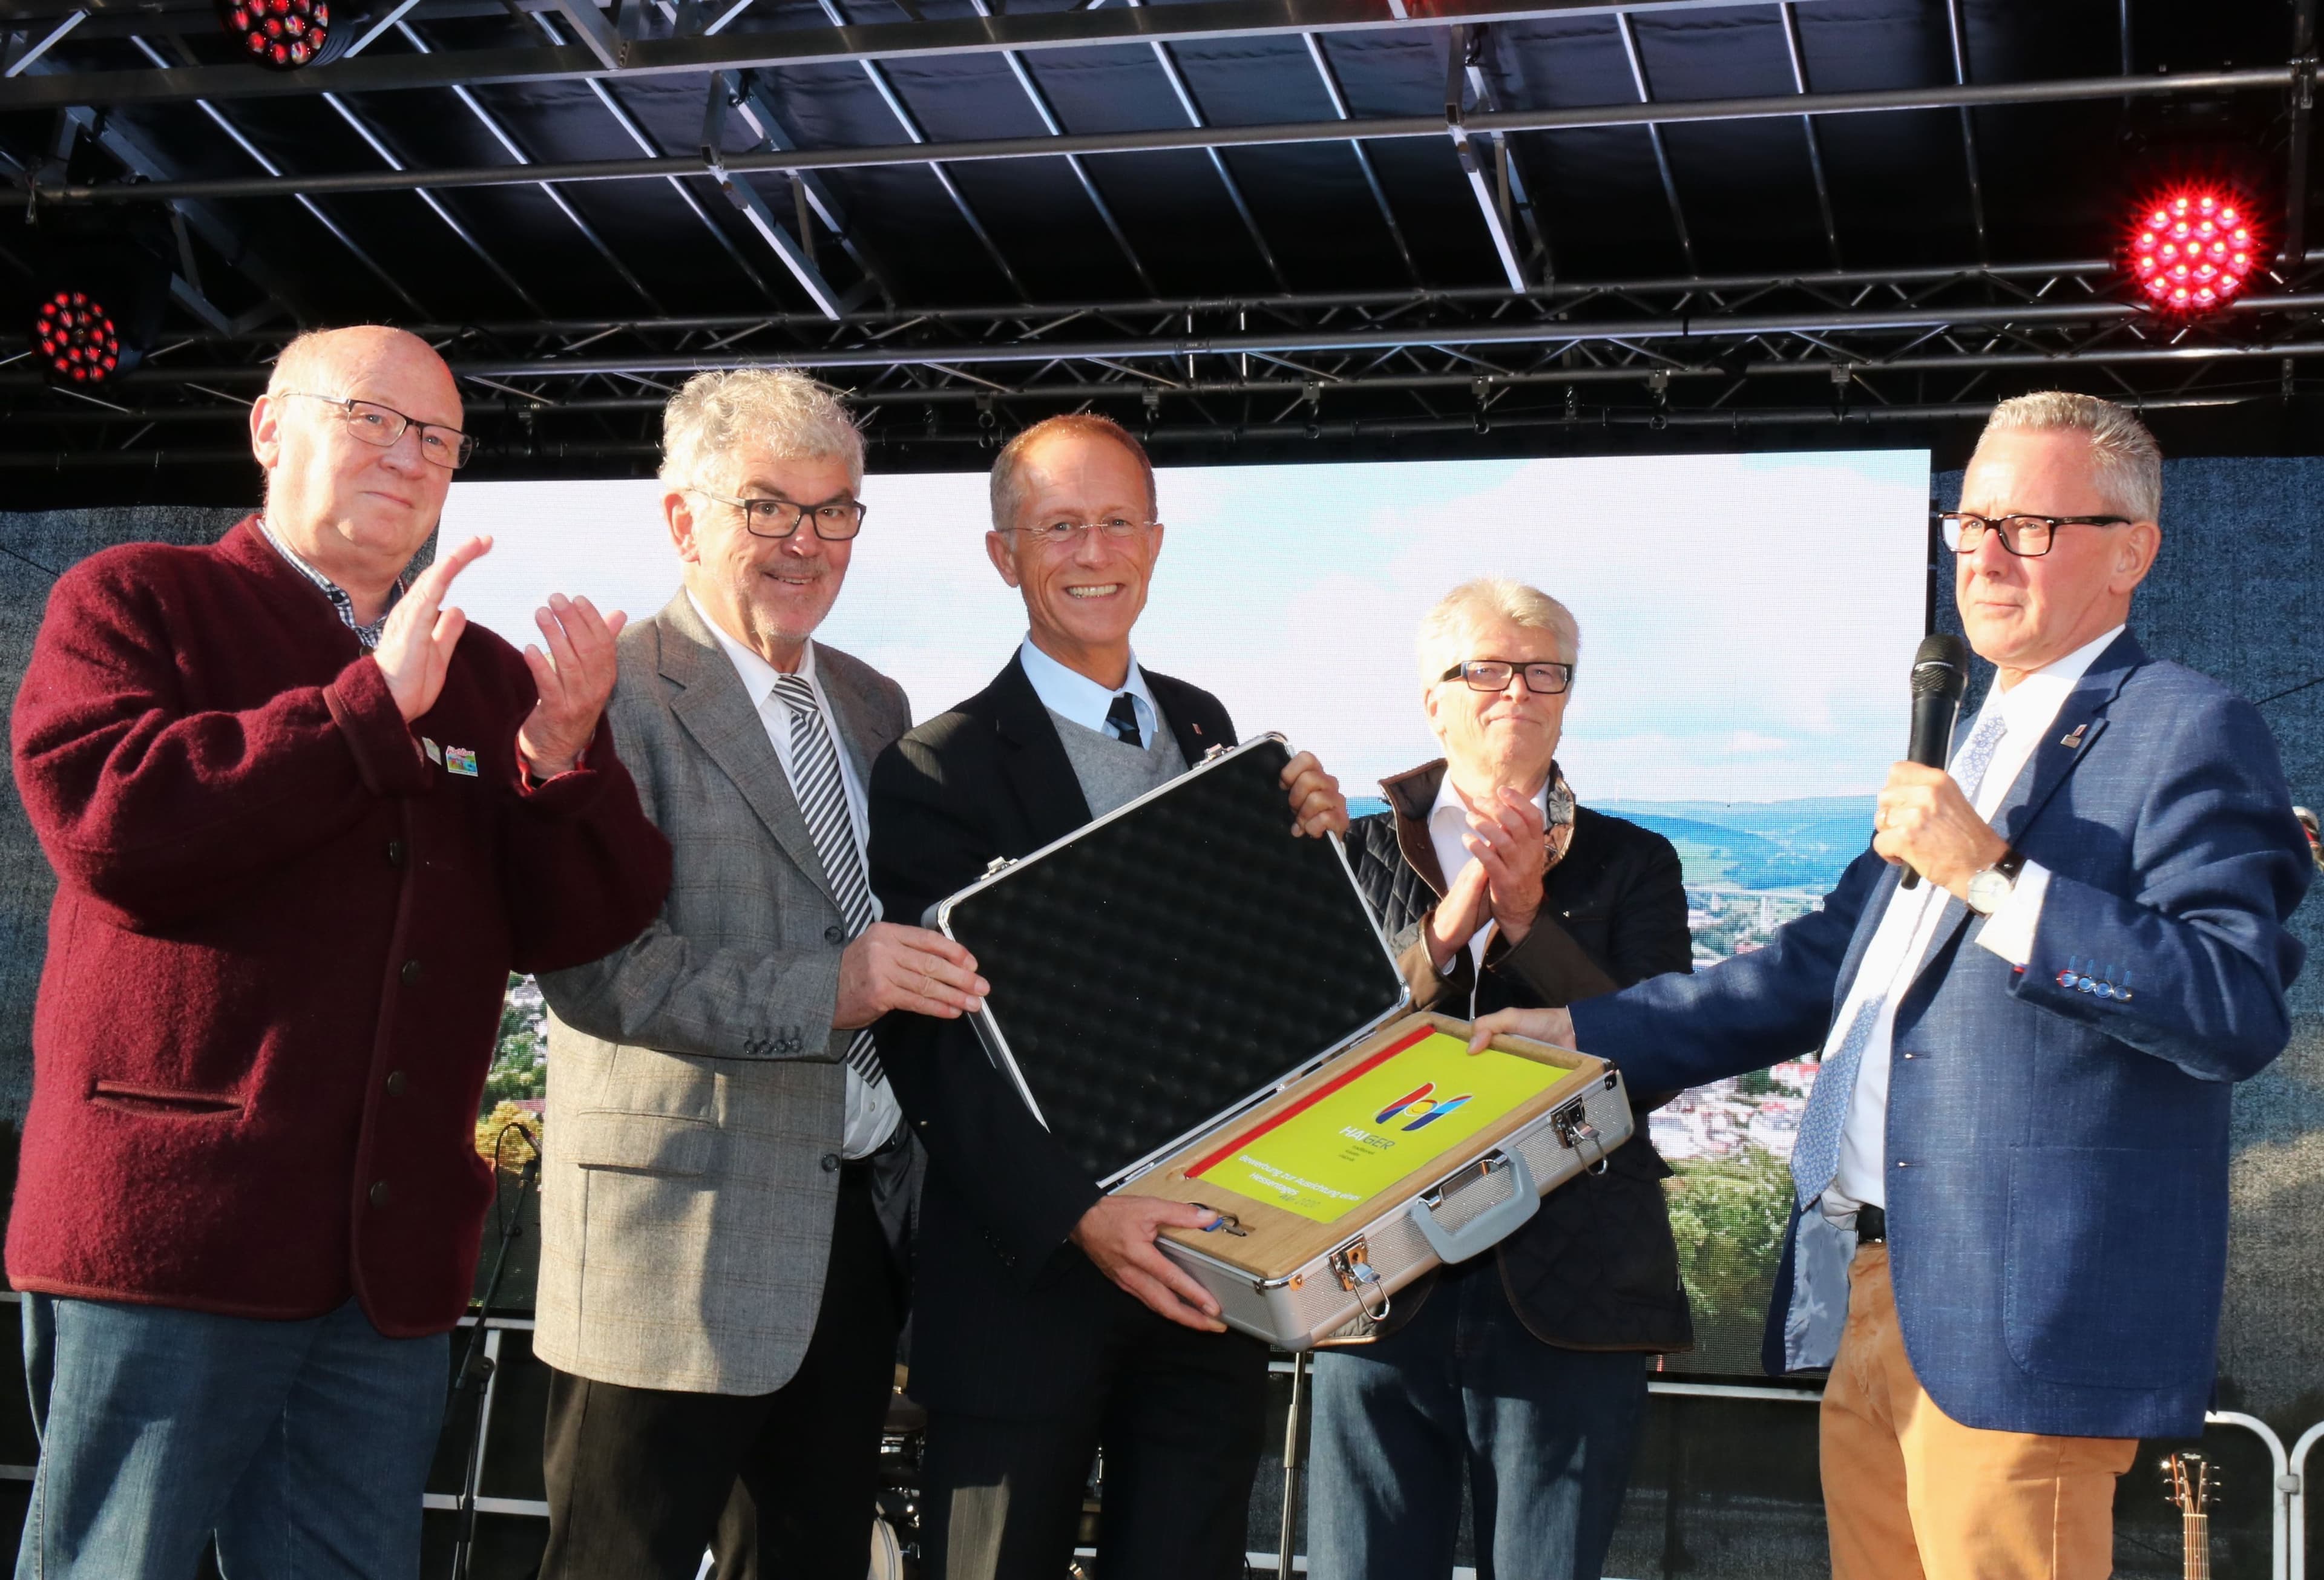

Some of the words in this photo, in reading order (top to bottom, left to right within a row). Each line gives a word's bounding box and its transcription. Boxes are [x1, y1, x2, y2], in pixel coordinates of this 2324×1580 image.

[1338, 1126, 1396, 1150] HAIGER
[1239, 1155, 1282, 1177] Bewerbung
[1281, 1172, 1297, 1181] zur
[1295, 1178, 1341, 1198] Ausrichtung
[1249, 1172, 1299, 1196] Hessentages
